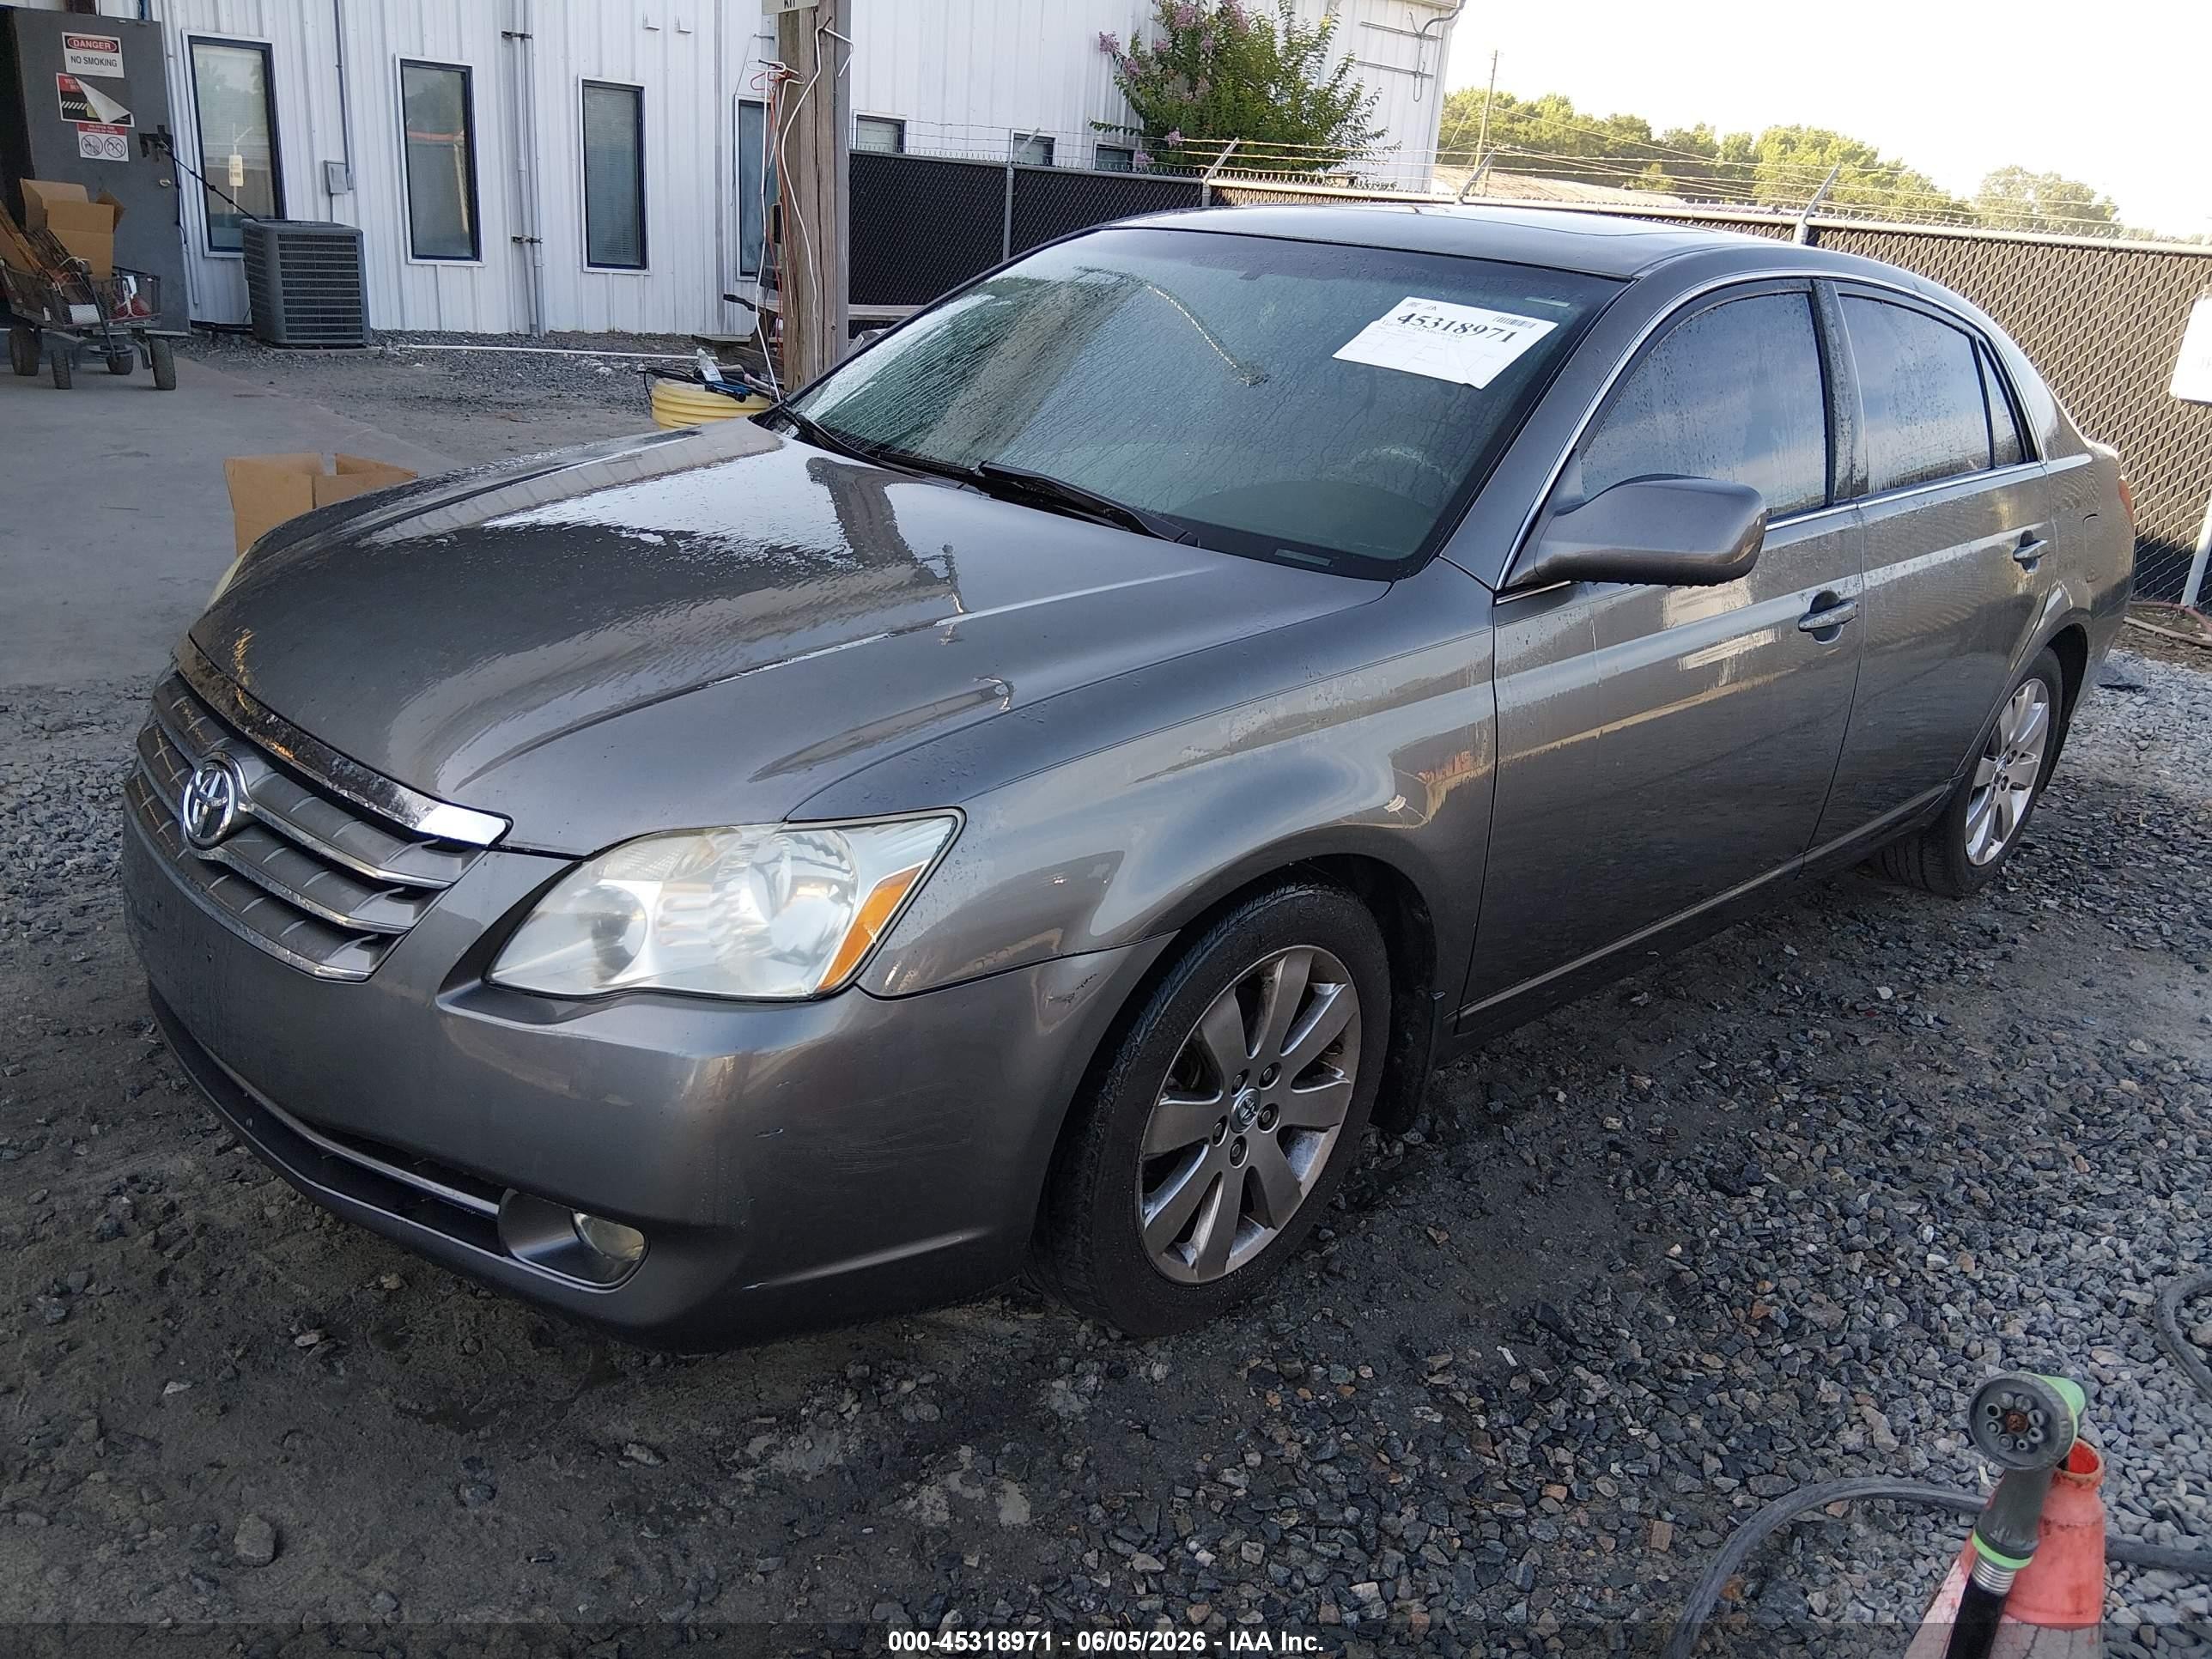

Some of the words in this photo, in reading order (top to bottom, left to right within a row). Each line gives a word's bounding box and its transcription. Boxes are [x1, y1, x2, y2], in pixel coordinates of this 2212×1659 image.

[73, 40, 112, 51] DANGER
[70, 56, 82, 64] NO
[83, 58, 118, 68] SMOKING
[1397, 313, 1518, 343] 45318971
